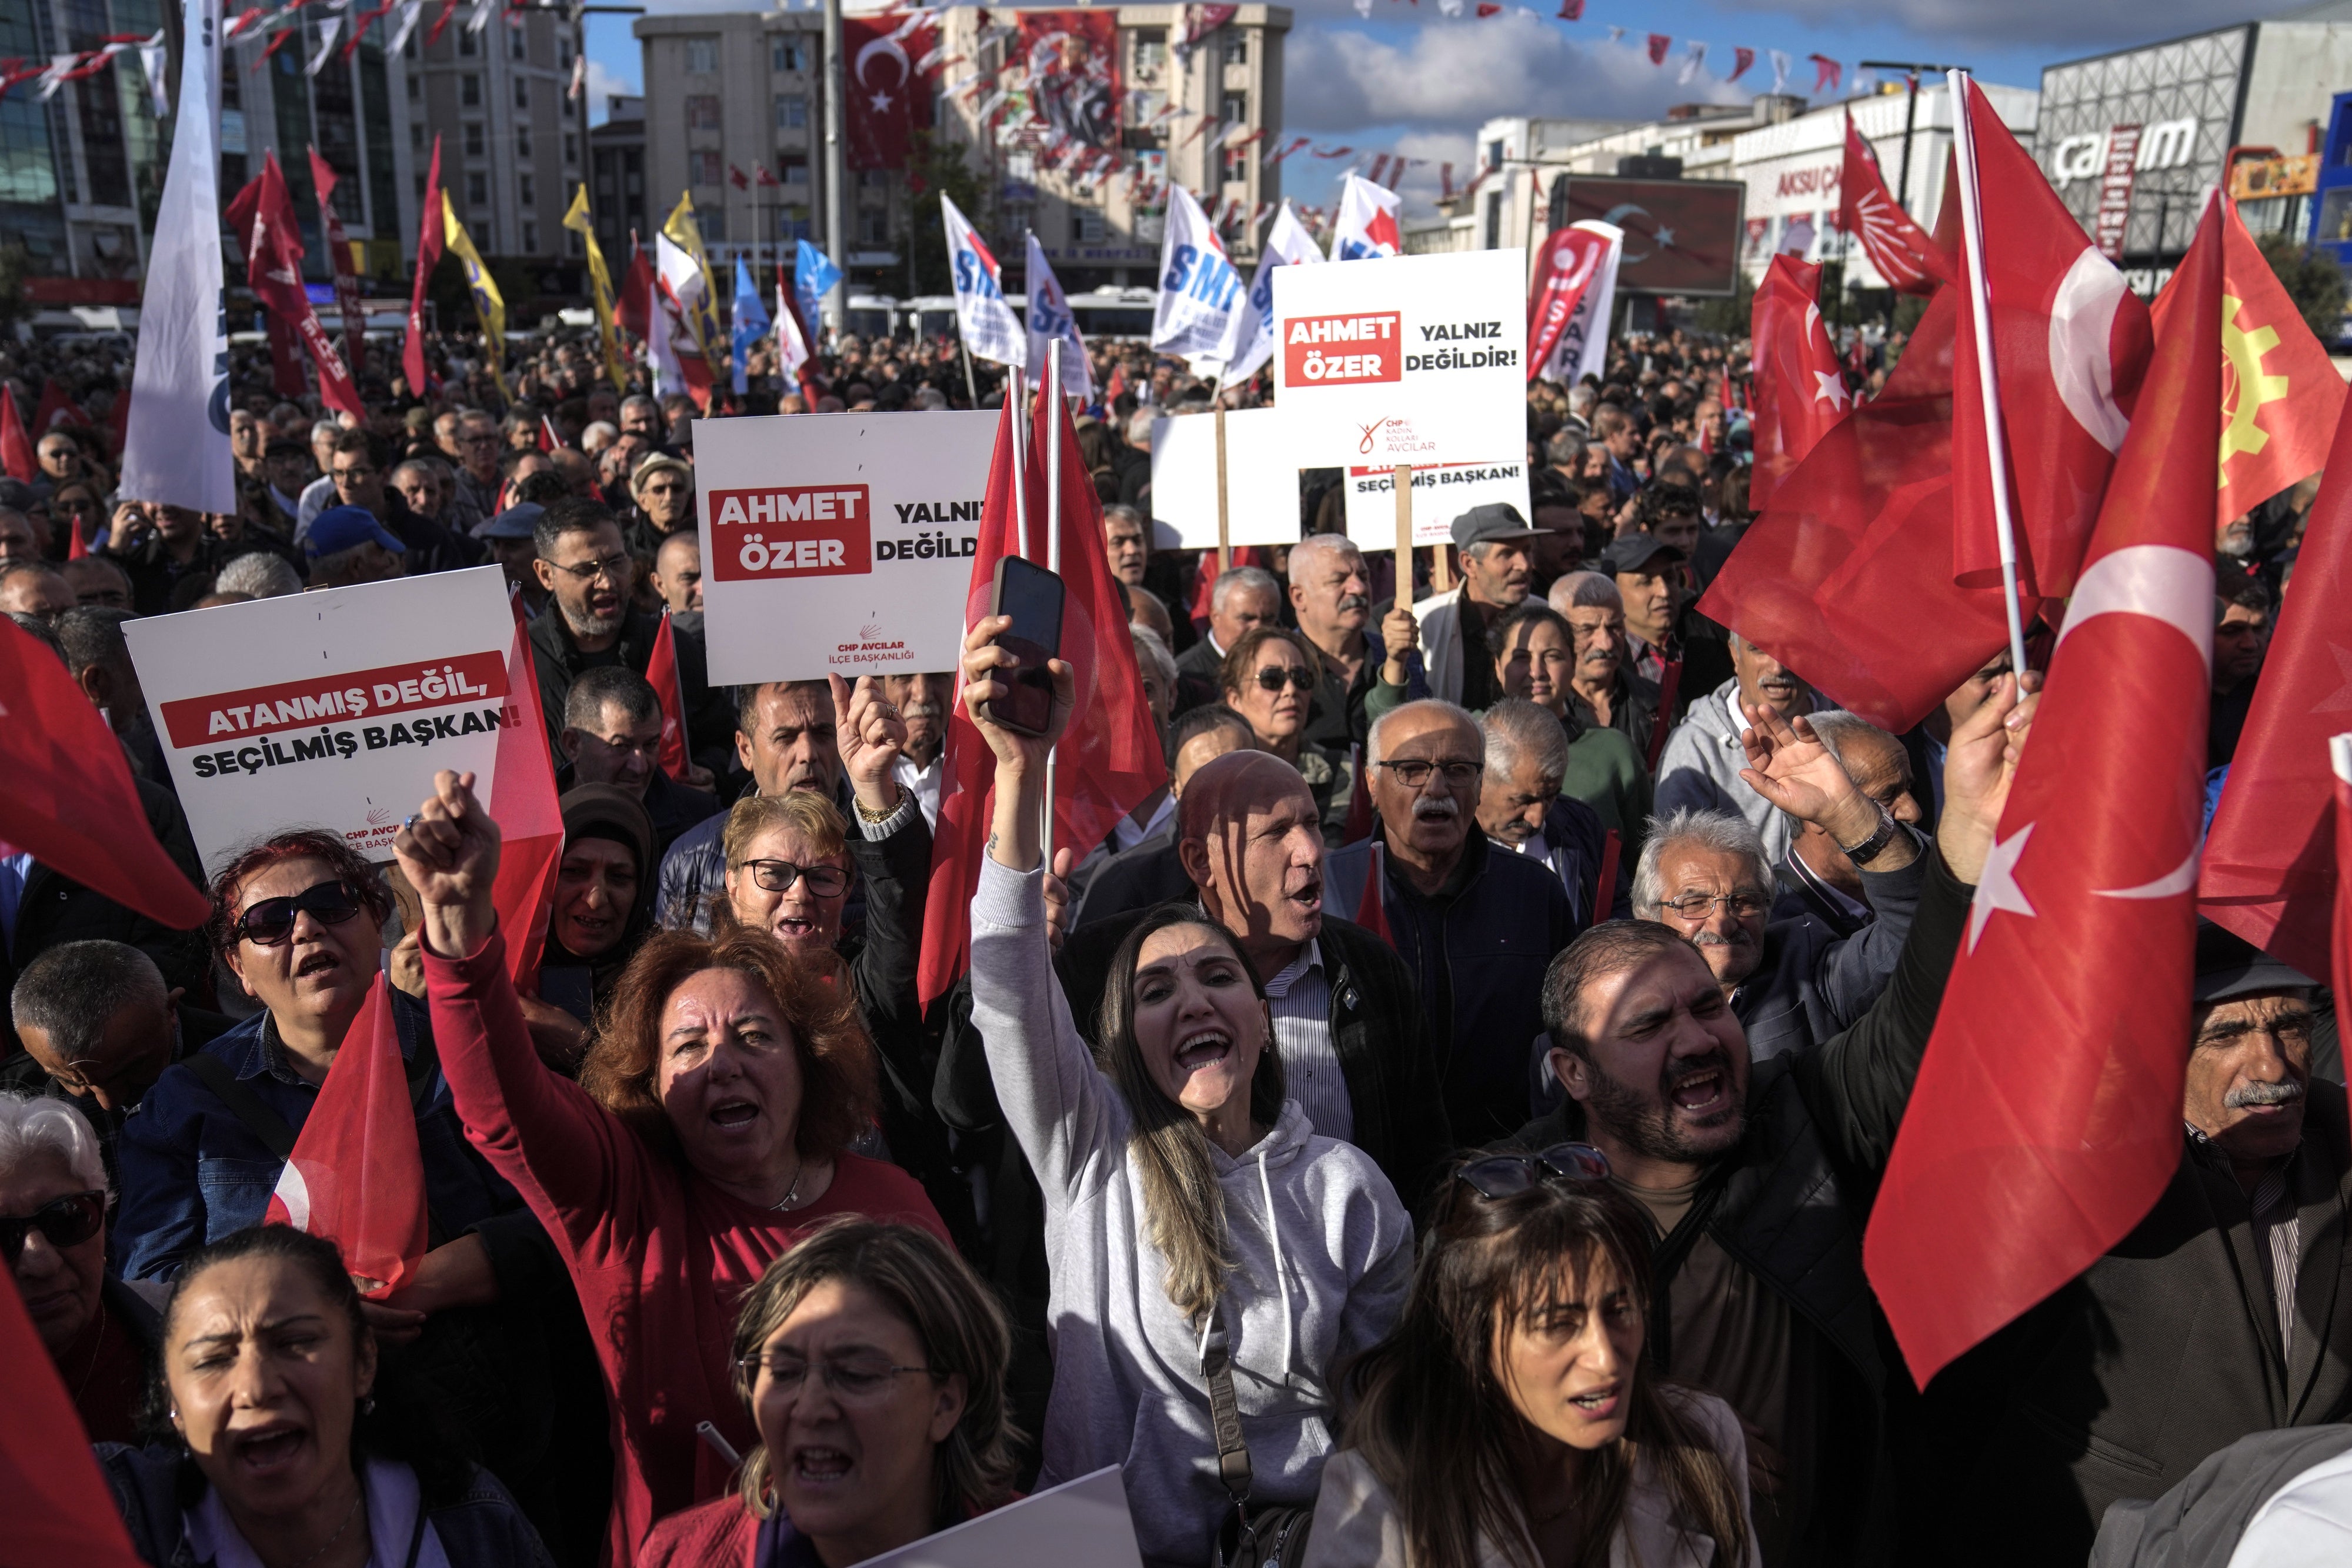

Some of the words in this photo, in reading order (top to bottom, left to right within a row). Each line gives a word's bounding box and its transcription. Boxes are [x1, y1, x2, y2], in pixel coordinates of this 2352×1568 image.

[1289, 316, 1396, 345] AHMET
[1420, 321, 1502, 342] YALNIZ
[1302, 349, 1383, 380] ÖZER
[1406, 346, 1517, 371] DEĞİLDİR!
[1386, 419, 1403, 428] CHP
[1387, 442, 1436, 452] AVCILAR
[1357, 470, 1436, 493] SEÇİMİŞ
[1440, 465, 1520, 485] BAŞKAN!
[717, 491, 863, 525] AHMET
[739, 533, 846, 572] ÖZER
[876, 531, 978, 562] DEĞİLD
[829, 654, 851, 665] İLÇE
[853, 650, 915, 663] BAŞKANLIĞI
[838, 643, 859, 652] CHP
[860, 641, 905, 651] AVCILAR
[208, 687, 368, 736] ATANMIŞ
[372, 665, 488, 709] DEĞİL,
[192, 726, 358, 779] SEÇİLMİŞ
[362, 705, 522, 750] BAŞKAN!
[345, 830, 369, 840] CHP
